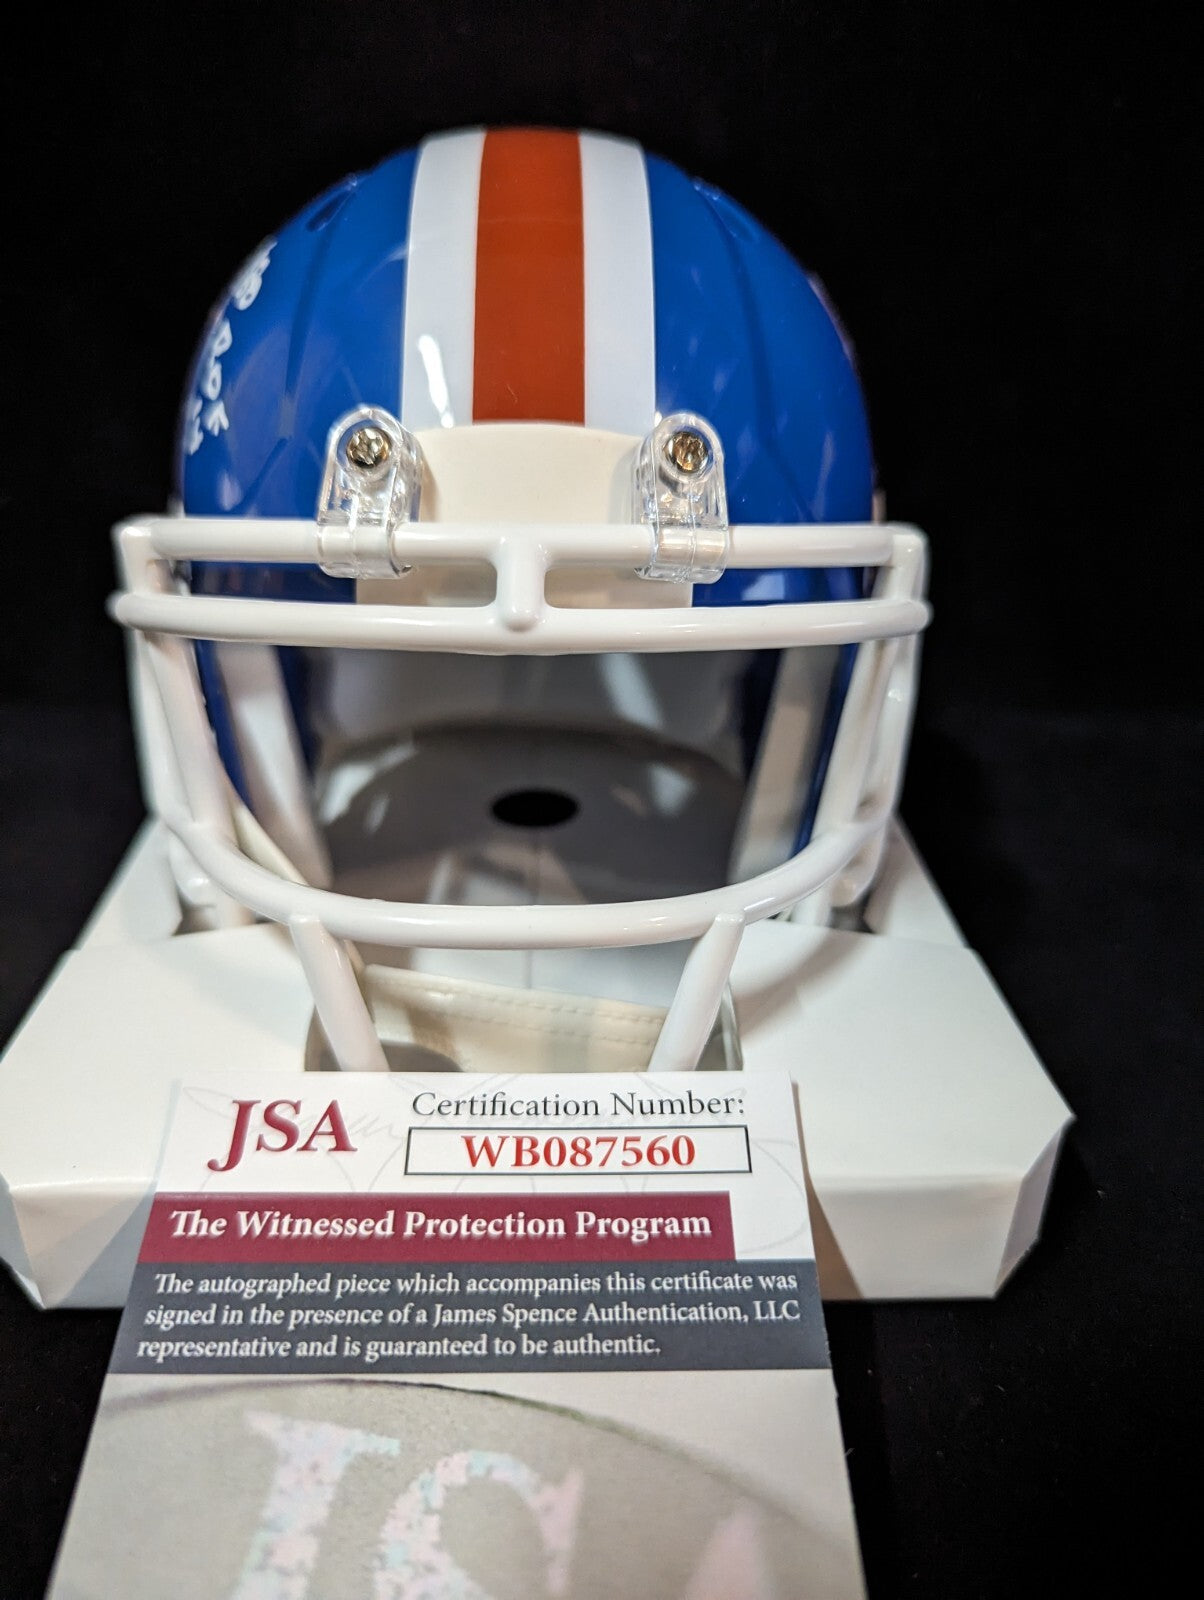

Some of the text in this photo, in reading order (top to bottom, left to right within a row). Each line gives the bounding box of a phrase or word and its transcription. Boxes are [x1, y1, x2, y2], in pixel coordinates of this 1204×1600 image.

[412, 1090, 745, 1117] Certification Number:
[207, 1099, 358, 1172] JSA
[460, 1134, 696, 1168] WB087560
[170, 1209, 712, 1244] The Witnessed Protection Program
[155, 1270, 797, 1300] The autographed piece which accompanies this certificate was
[144, 1300, 800, 1331] signed in the presence of a James Spence Authentication, LLC
[137, 1334, 661, 1364] representative and is guaranteed to be authentic.
